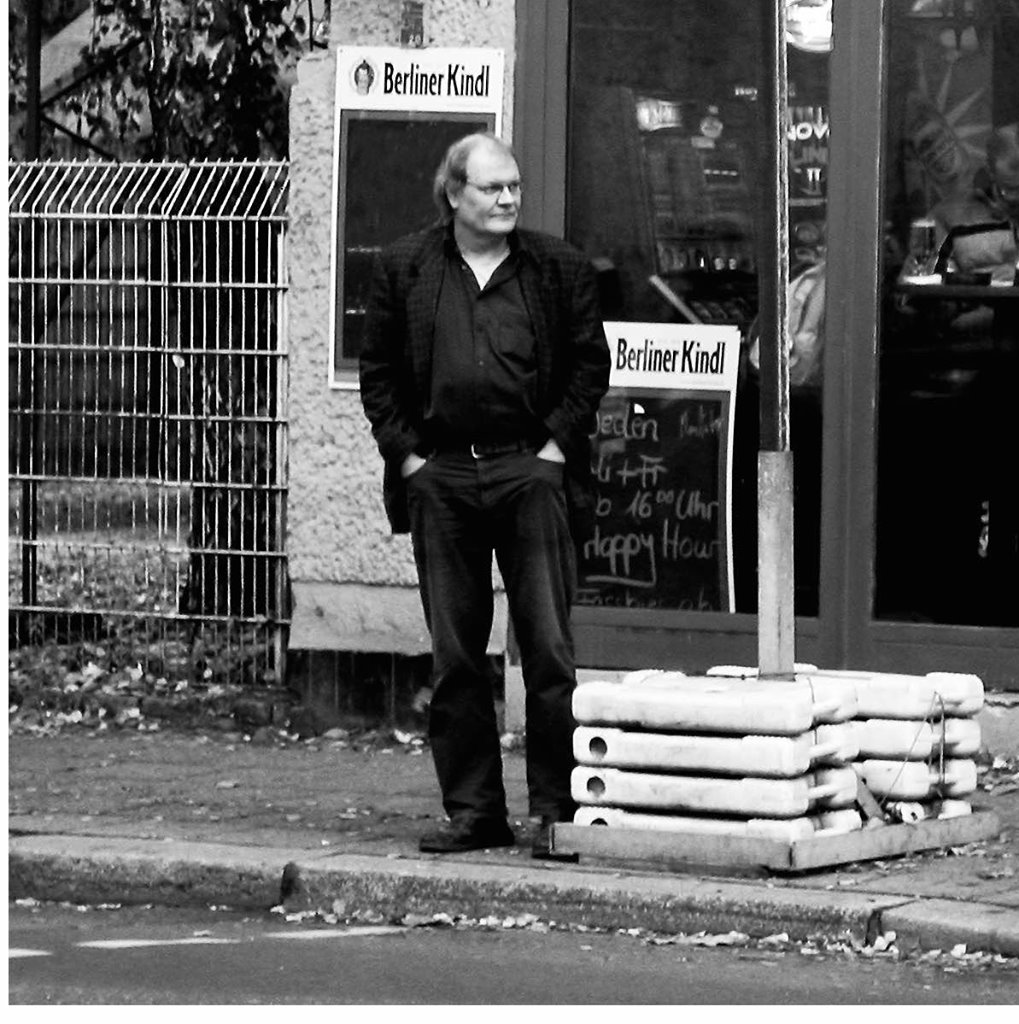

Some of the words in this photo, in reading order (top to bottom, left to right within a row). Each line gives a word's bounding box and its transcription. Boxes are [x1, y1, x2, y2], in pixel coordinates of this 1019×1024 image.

[384, 62, 444, 96] Berliner
[447, 64, 489, 97] Kindl
[616, 338, 679, 373] Berliner
[681, 341, 725, 375] Kindl
[675, 490, 720, 521] Uhr
[663, 518, 722, 559] Hour
